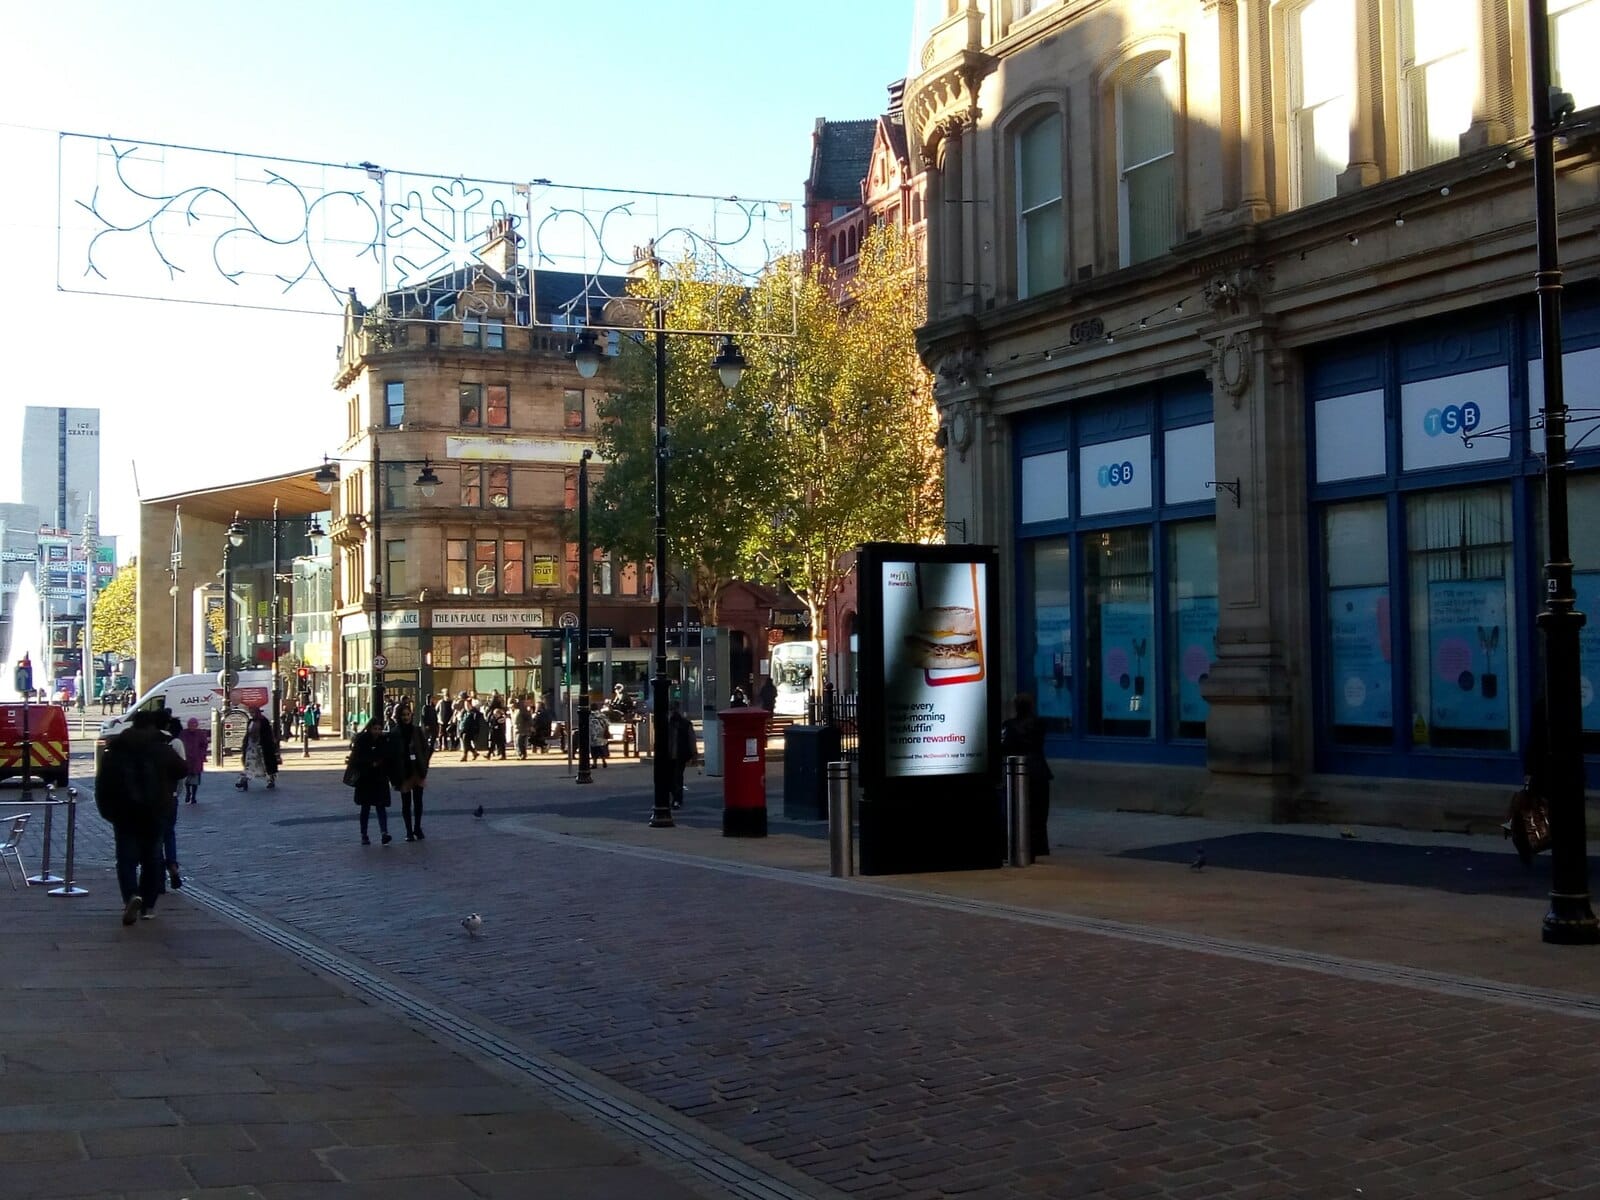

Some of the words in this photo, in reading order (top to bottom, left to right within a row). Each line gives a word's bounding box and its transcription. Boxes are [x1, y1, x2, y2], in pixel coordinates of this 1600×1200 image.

[1427, 405, 1477, 435] TSB
[1100, 464, 1132, 485] TSB
[434, 613, 449, 623] THE
[450, 614, 459, 623] IN
[461, 613, 486, 623] PLAICE
[492, 613, 508, 623] FISH
[520, 613, 542, 622] CHIPS
[375, 658, 386, 666] 20
[179, 696, 199, 705] AAH
[911, 702, 934, 712] every
[889, 711, 946, 723] -morning
[898, 736, 922, 745] more
[922, 733, 966, 745] rewarding
